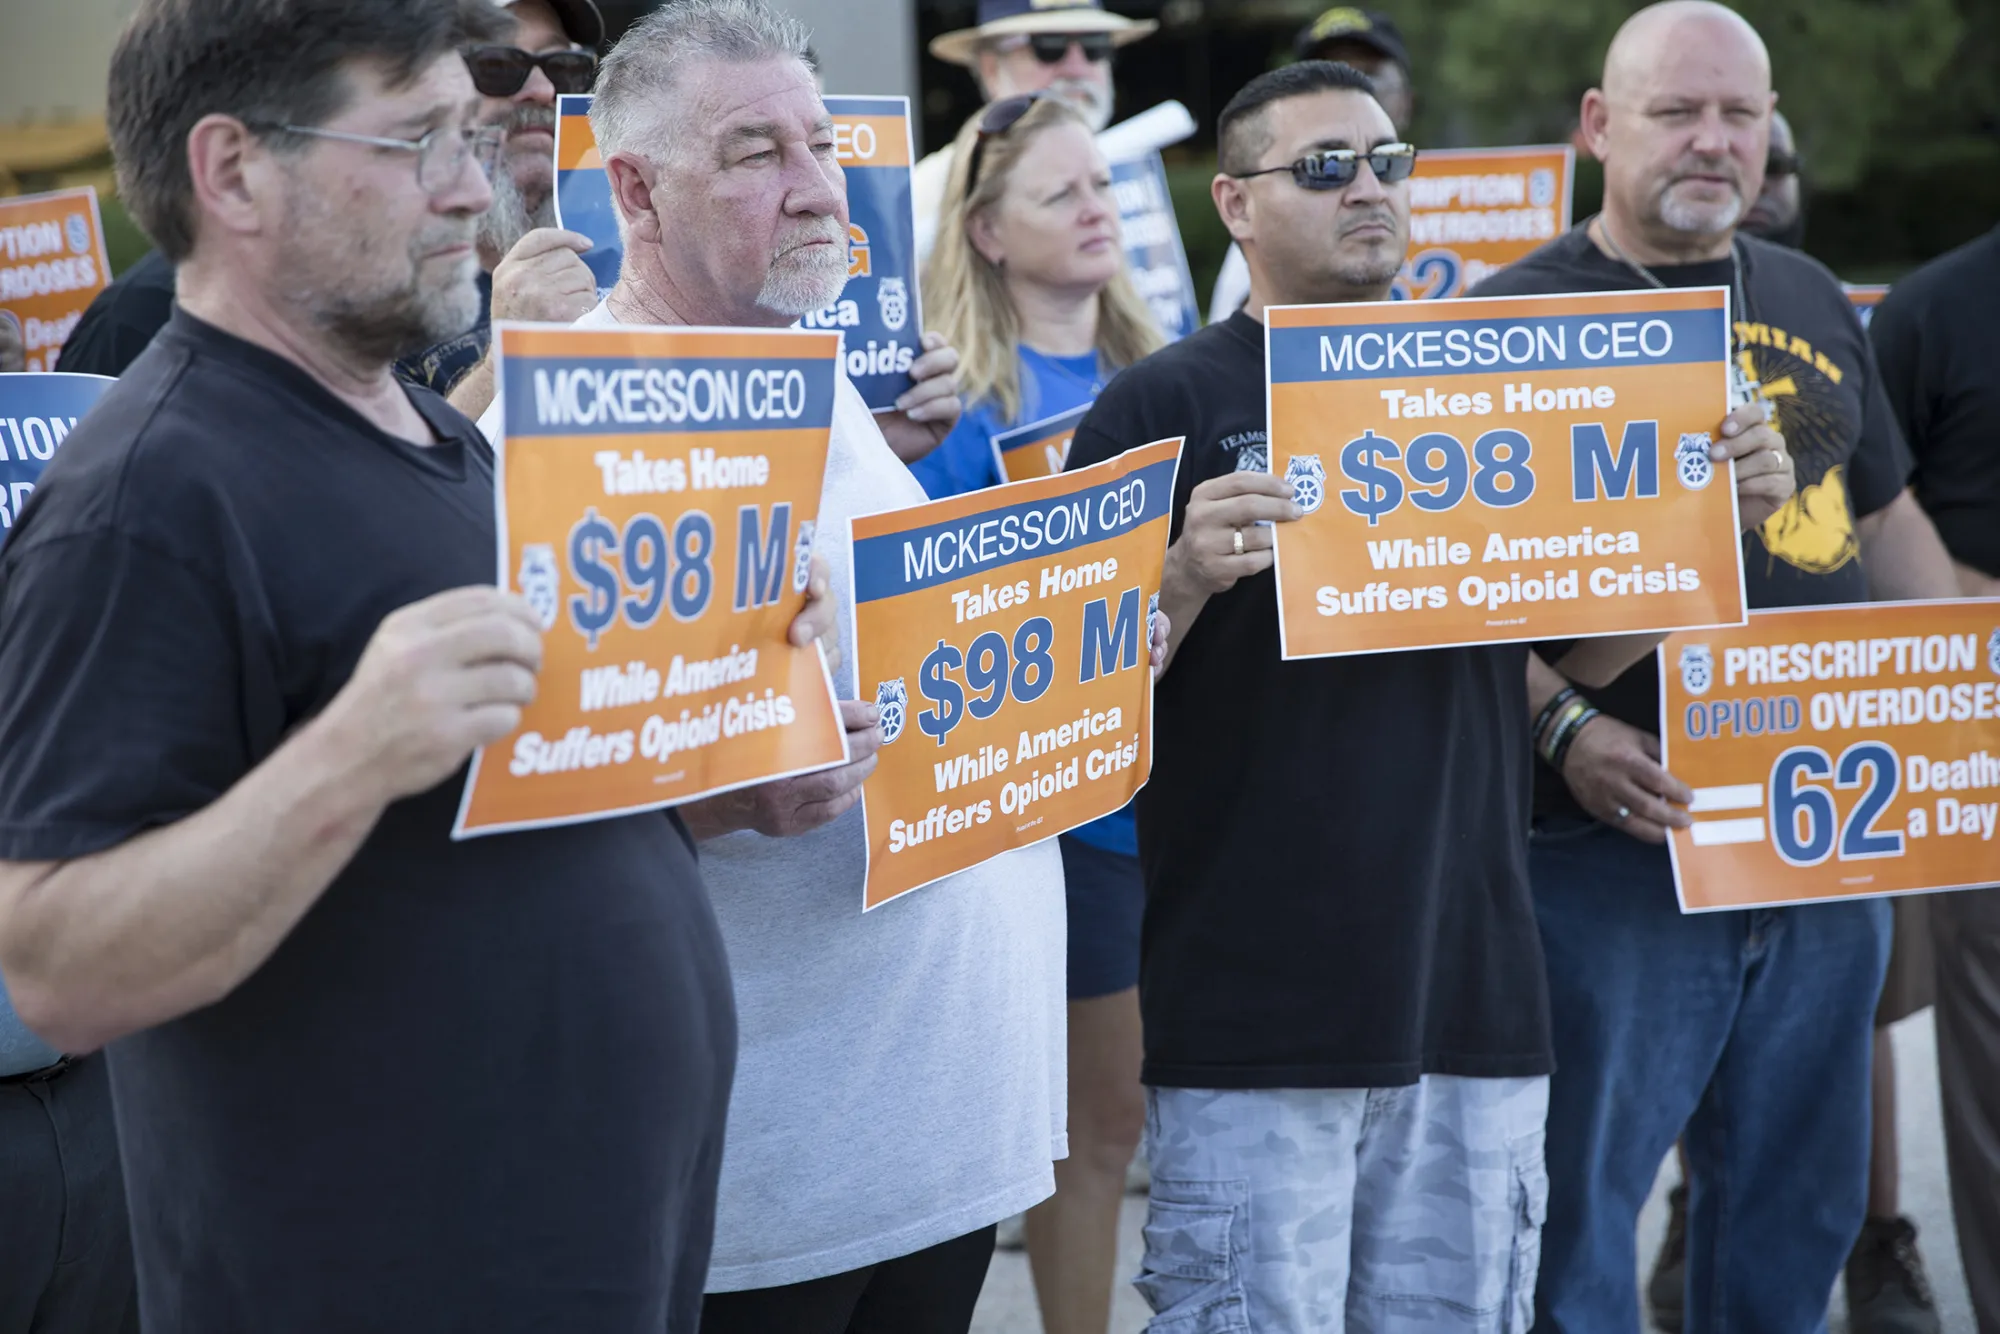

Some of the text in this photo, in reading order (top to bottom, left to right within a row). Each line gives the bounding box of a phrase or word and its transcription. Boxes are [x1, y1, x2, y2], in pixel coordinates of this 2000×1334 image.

[833, 123, 876, 160] EO
[1410, 173, 1526, 208] RIPTION
[0, 219, 63, 260] TION
[1410, 207, 1555, 245] VERDOSES
[0, 254, 97, 300] RDOSES
[805, 300, 860, 328] ica
[1319, 319, 1674, 372] MCKESSON CEO
[533, 368, 806, 425] MCKESSON CEO
[1380, 382, 1616, 419] Takes Home
[0, 416, 78, 462] TION
[1219, 430, 1267, 452] TEAMS
[593, 447, 770, 496] Takes Home
[1339, 418, 1660, 528] $98 M
[902, 478, 1146, 583] MCKESSON CEO
[1366, 526, 1640, 571] While America
[567, 501, 793, 652] $98 M
[951, 556, 1118, 624] Takes Home
[1316, 562, 1701, 617] Suffers Opioid Crisis
[580, 643, 758, 712] While America
[918, 585, 1141, 747] $98 M
[1724, 633, 1977, 687] PRESCRIPTION
[508, 688, 796, 778] Suffers Opioid Crisis
[1684, 695, 1802, 741] OPIOID
[933, 706, 1122, 793] While America
[888, 733, 1139, 854] Suffers Opioid Crisi
[1768, 740, 1906, 868] 62
[1906, 750, 2000, 793] Death
[1907, 797, 1999, 841] a Day
